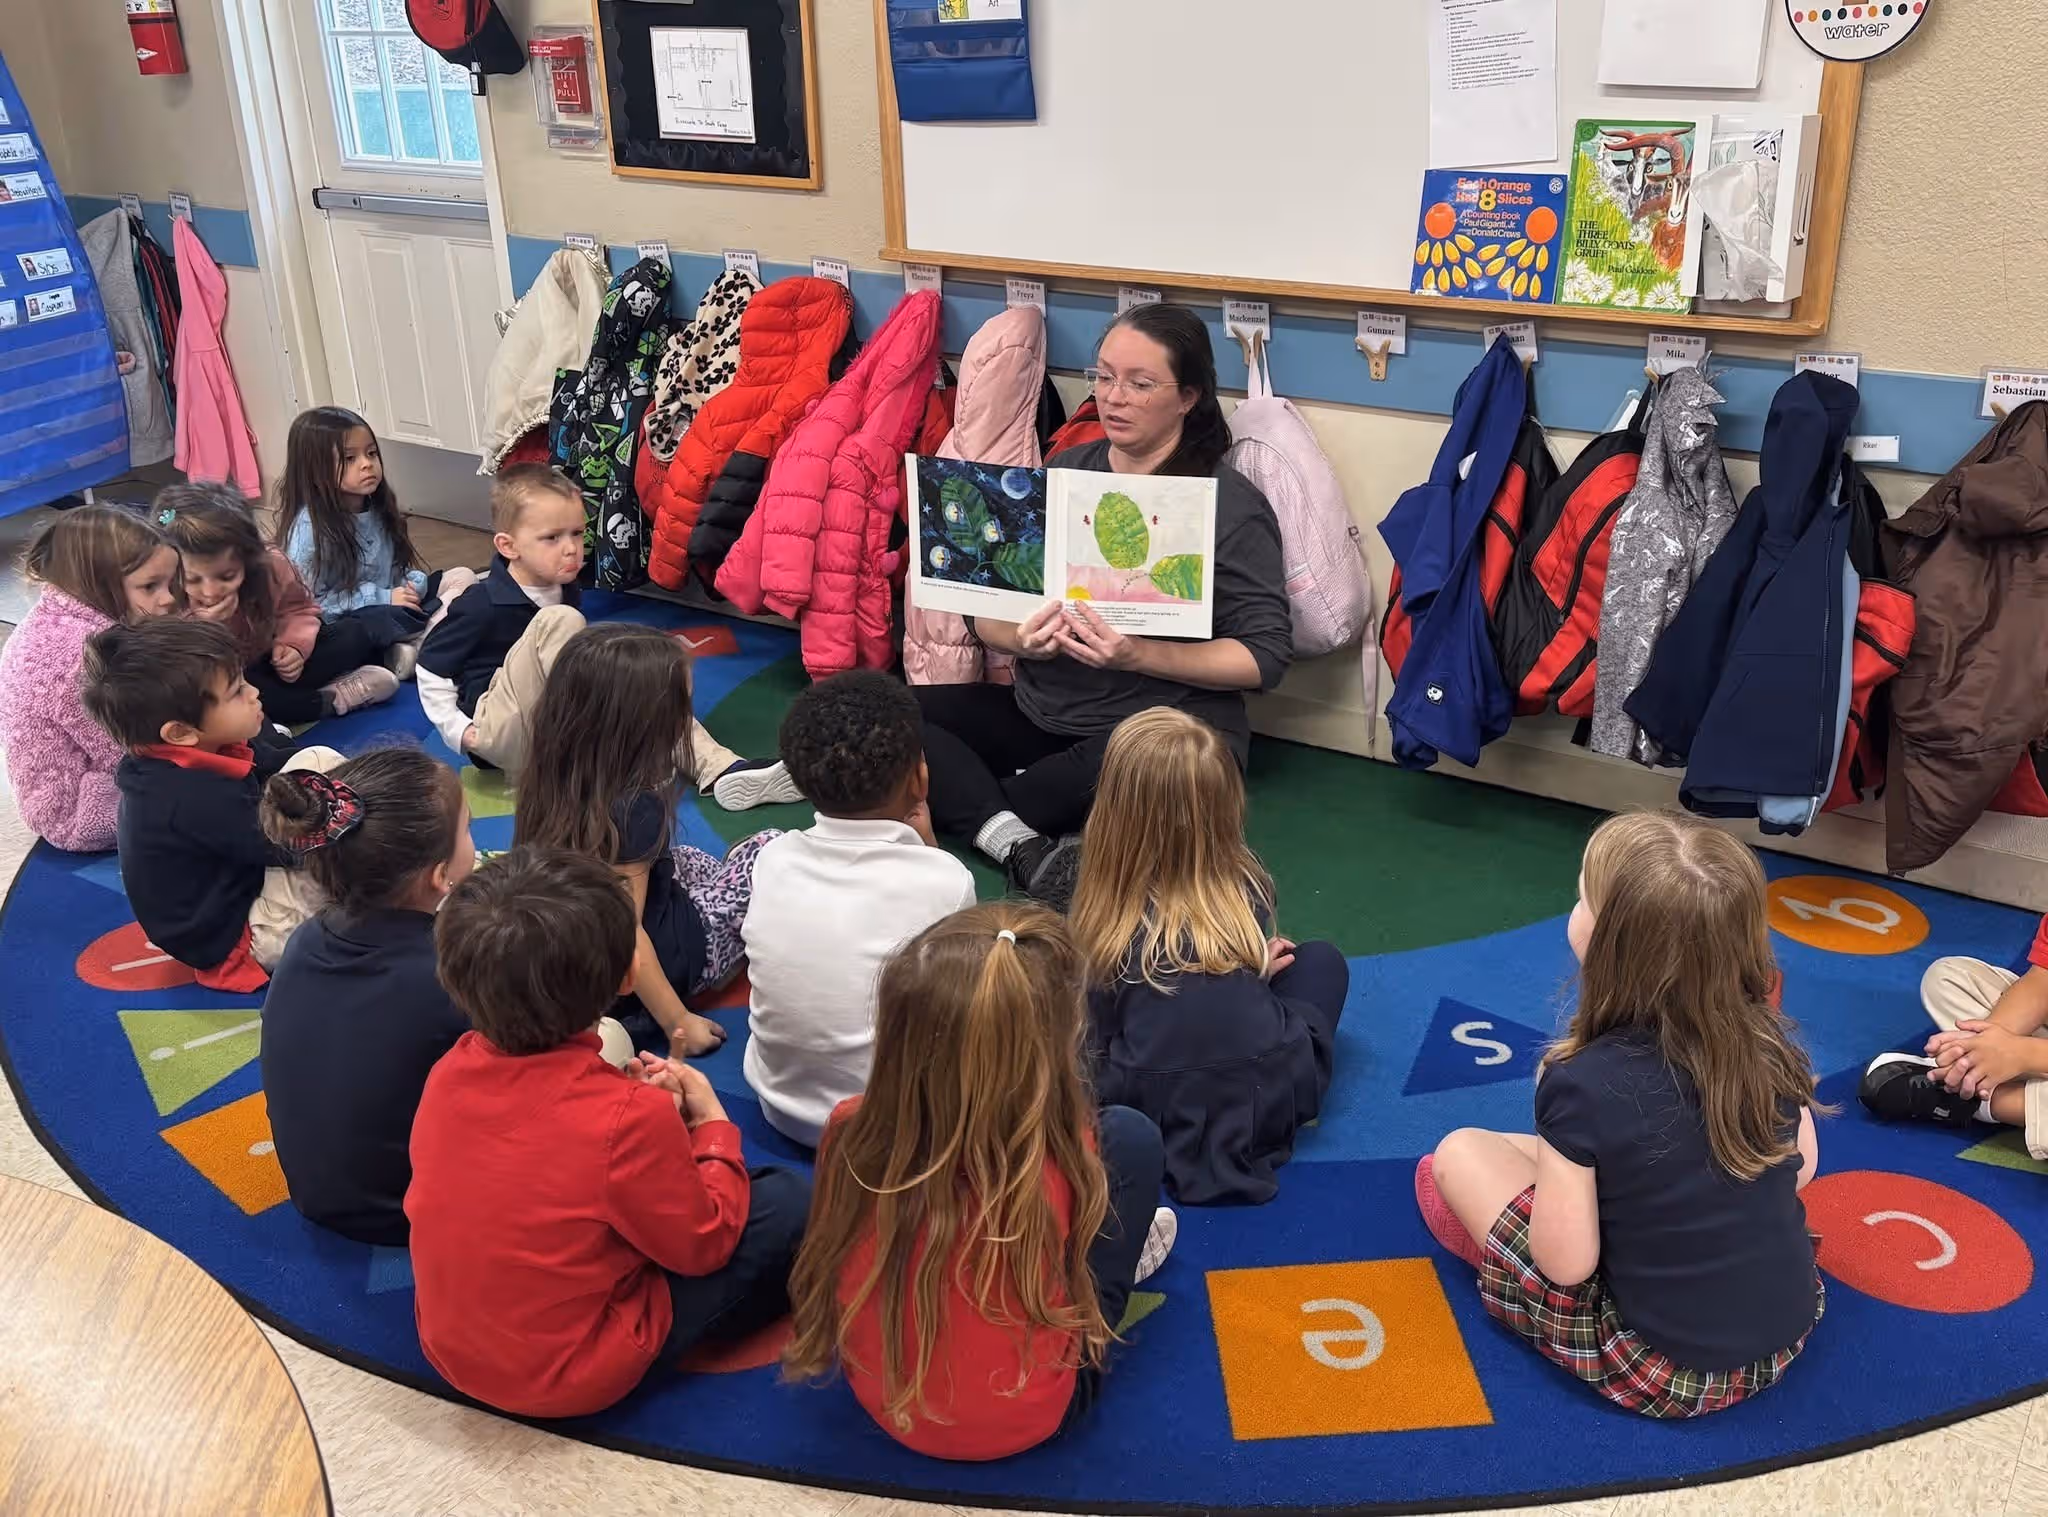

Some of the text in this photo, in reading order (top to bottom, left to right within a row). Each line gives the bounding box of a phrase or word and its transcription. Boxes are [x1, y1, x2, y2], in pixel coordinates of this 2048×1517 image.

[1825, 23, 1890, 40] water
[556, 73, 573, 81] LIFT
[557, 89, 577, 97] PULL
[1457, 178, 1532, 192] Each Orange
[1456, 189, 1533, 211] Had 8 Slices
[1467, 210, 1501, 221] Counting
[1501, 212, 1521, 220] Book
[1463, 219, 1479, 228] Paul
[1579, 220, 1598, 230] THE
[1471, 228, 1497, 237] Donald
[1497, 229, 1521, 238] Crews
[1578, 230, 1609, 240] THREE
[1576, 239, 1636, 250] BILLY GOATS
[1575, 248, 1608, 258] GRUFF
[1607, 265, 1624, 274] Paul
[1016, 289, 1034, 299] Freya
[1229, 313, 1266, 324] Mackenzie
[1367, 326, 1396, 336] Gunnar
[1666, 349, 1686, 358] Mila
[1992, 384, 2046, 397] Sebastian
[1300, 1298, 1386, 1370] e
